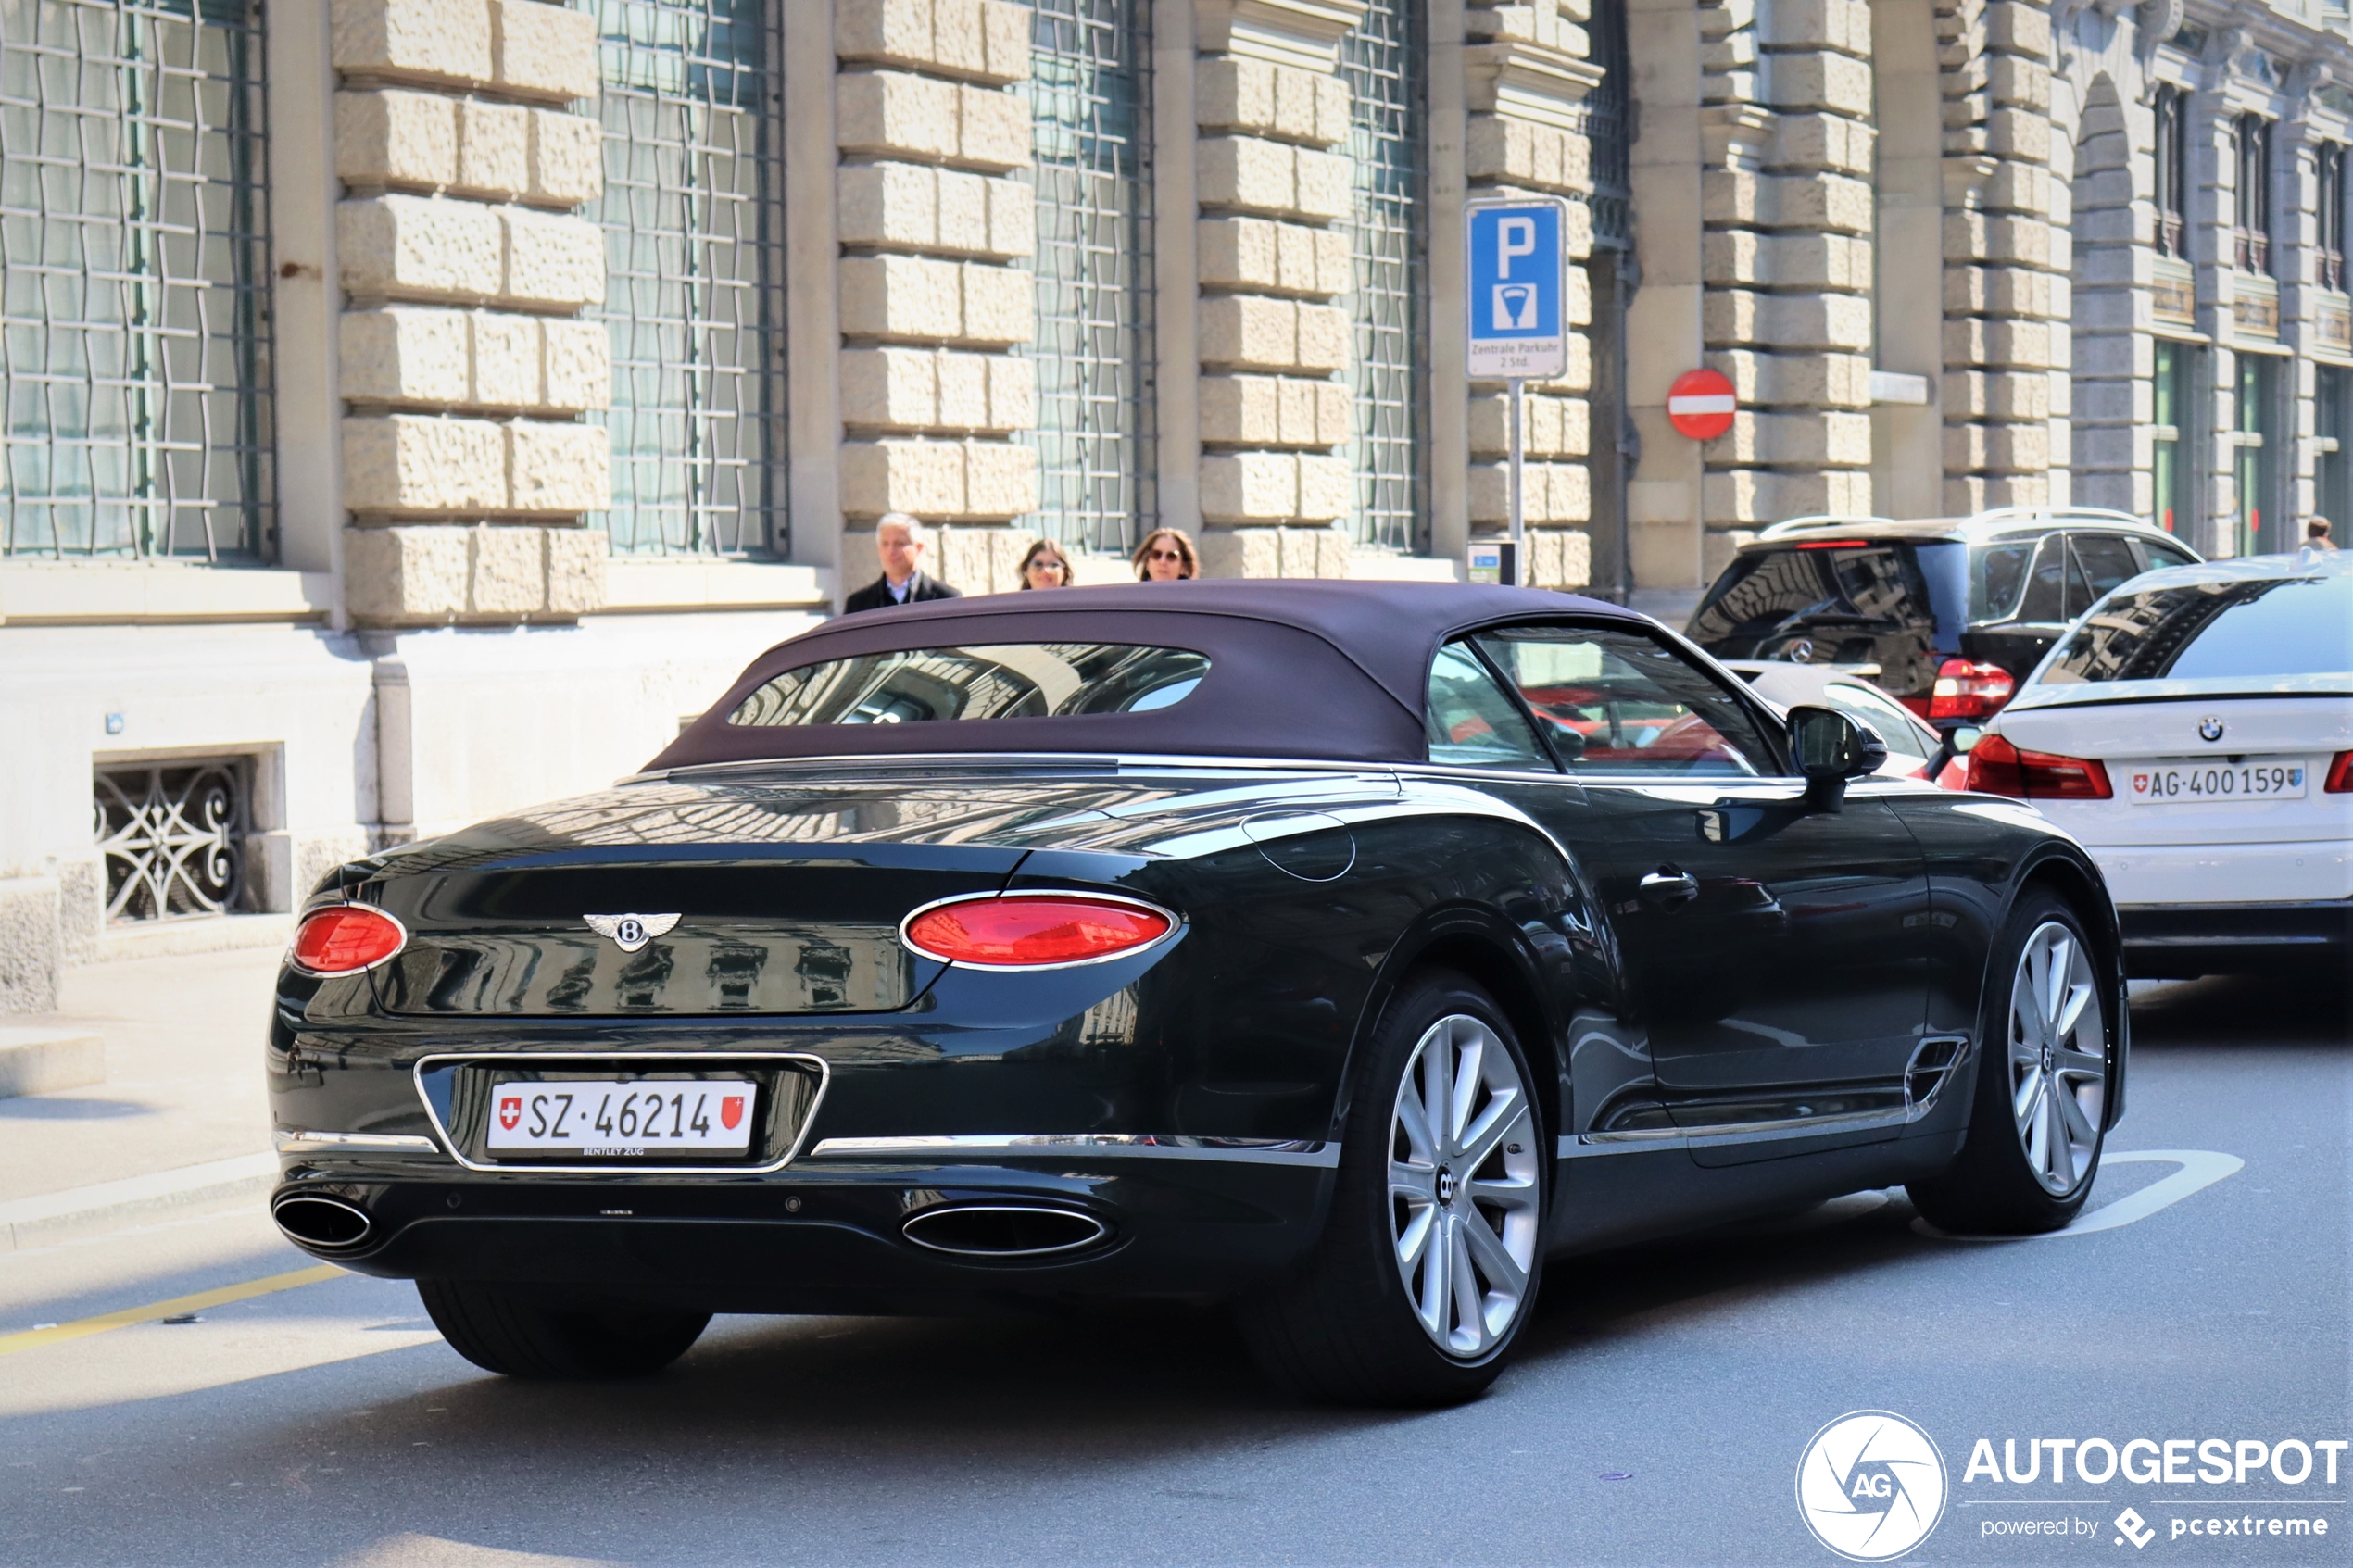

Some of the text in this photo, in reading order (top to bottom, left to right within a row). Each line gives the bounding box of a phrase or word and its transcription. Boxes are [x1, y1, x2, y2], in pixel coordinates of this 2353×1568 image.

[1498, 217, 1536, 280] P
[1472, 342, 1559, 355] Zentrale Parkuhr
[1501, 357, 1506, 367] 2
[621, 921, 639, 942] B
[583, 1148, 644, 1156] BENTLEY ZUG
